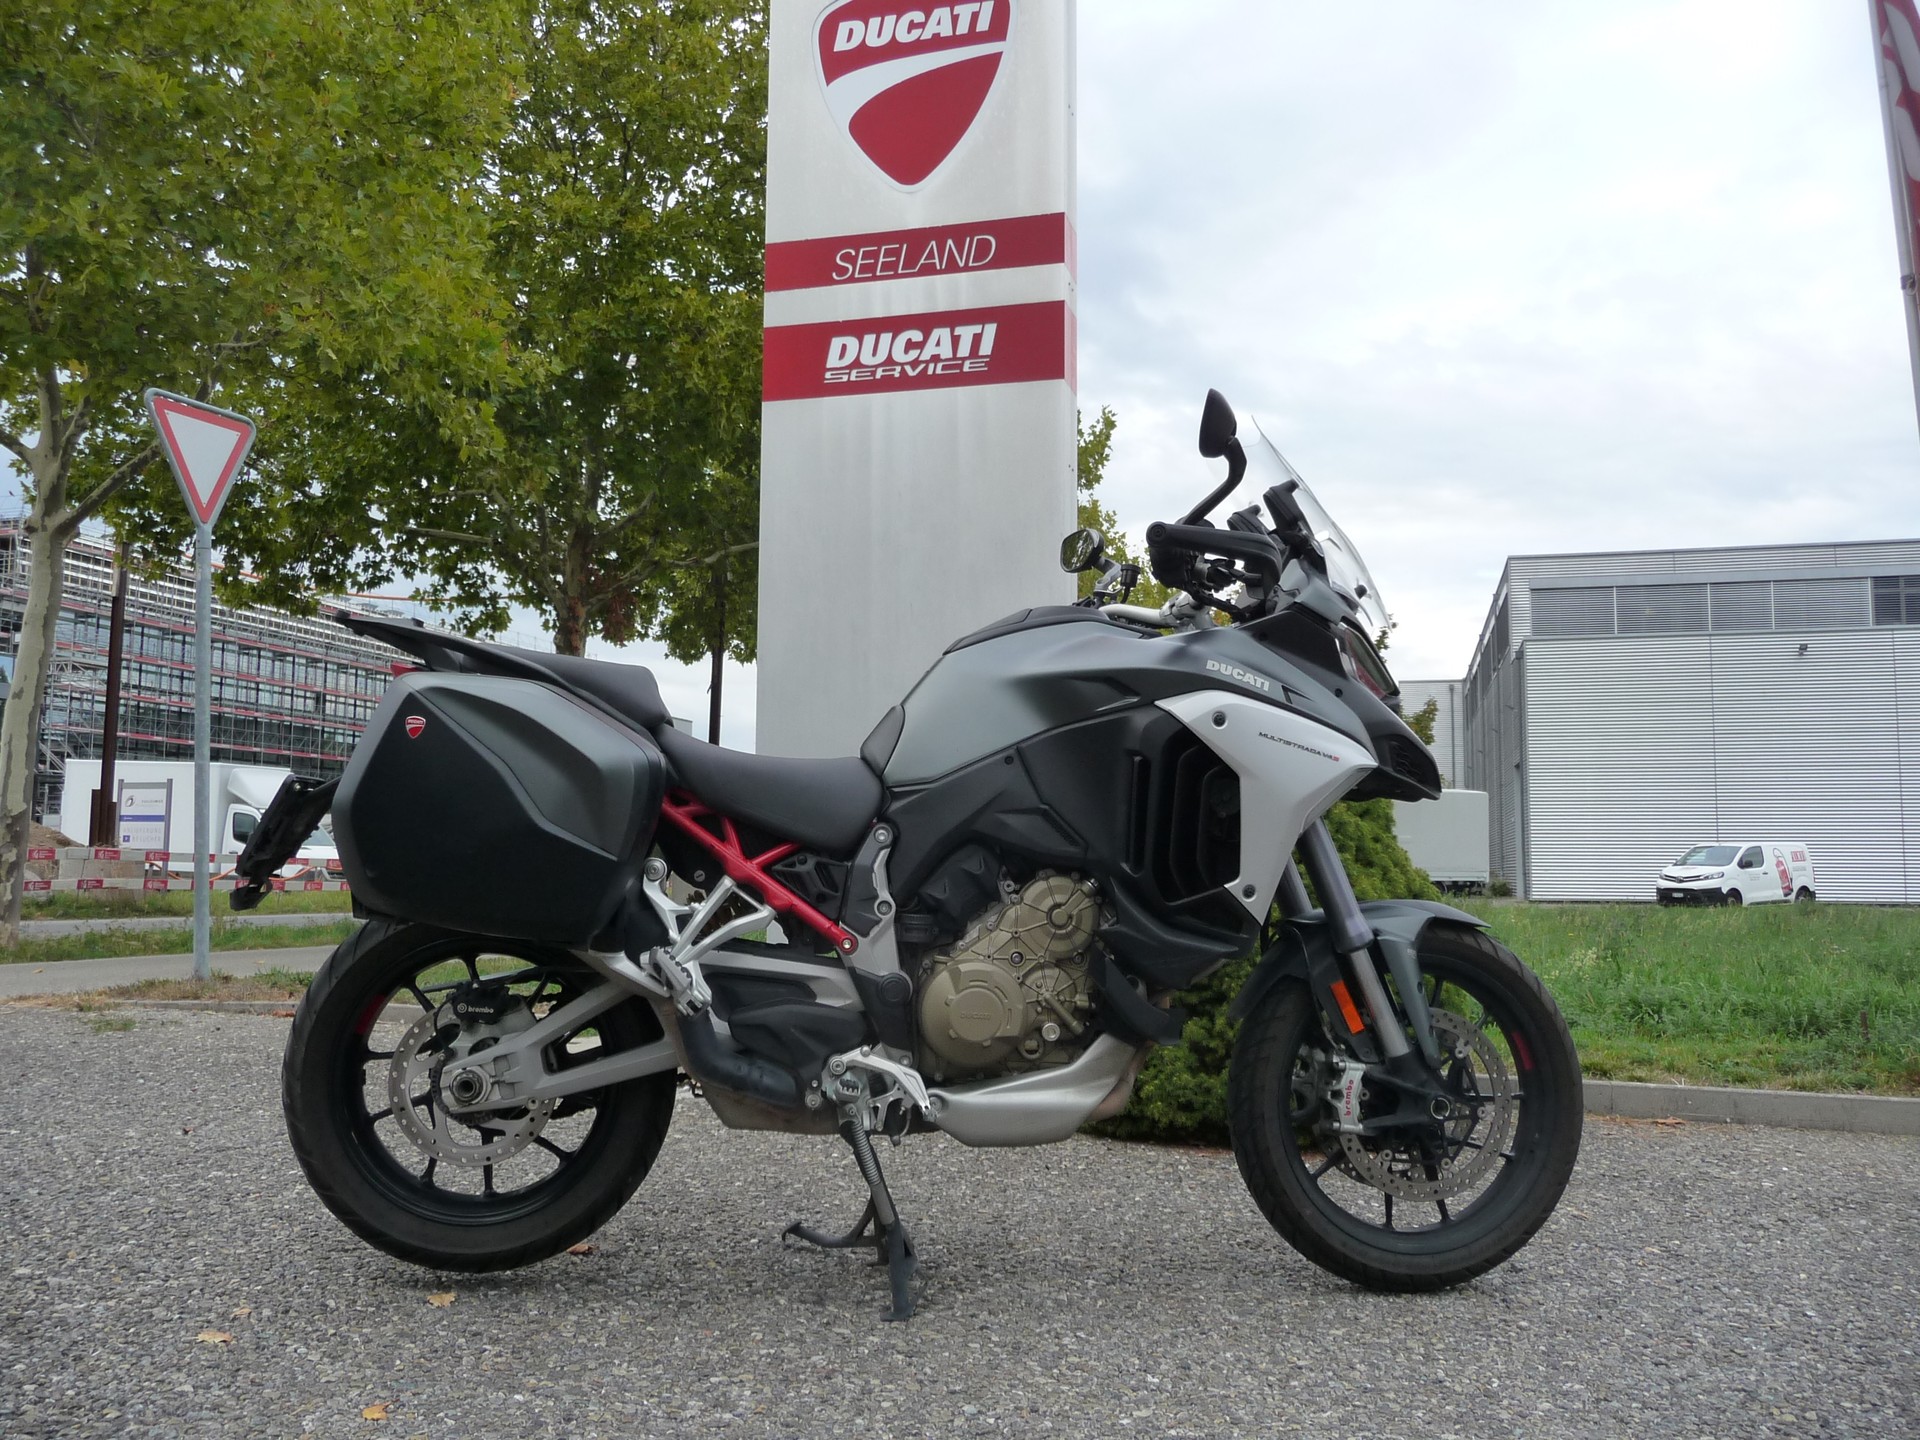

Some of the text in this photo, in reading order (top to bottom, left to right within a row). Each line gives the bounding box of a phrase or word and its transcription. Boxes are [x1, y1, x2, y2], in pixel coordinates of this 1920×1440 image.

[833, 0, 995, 52] DUCATI
[832, 235, 996, 281] SEELAND
[826, 323, 998, 369] DUCATI
[824, 358, 990, 383] SERVICE
[1206, 659, 1270, 691] DUCATI
[1258, 731, 1322, 756] MULTISTRADA
[468, 1005, 494, 1013] brembo
[1344, 1079, 1354, 1117] brembo
